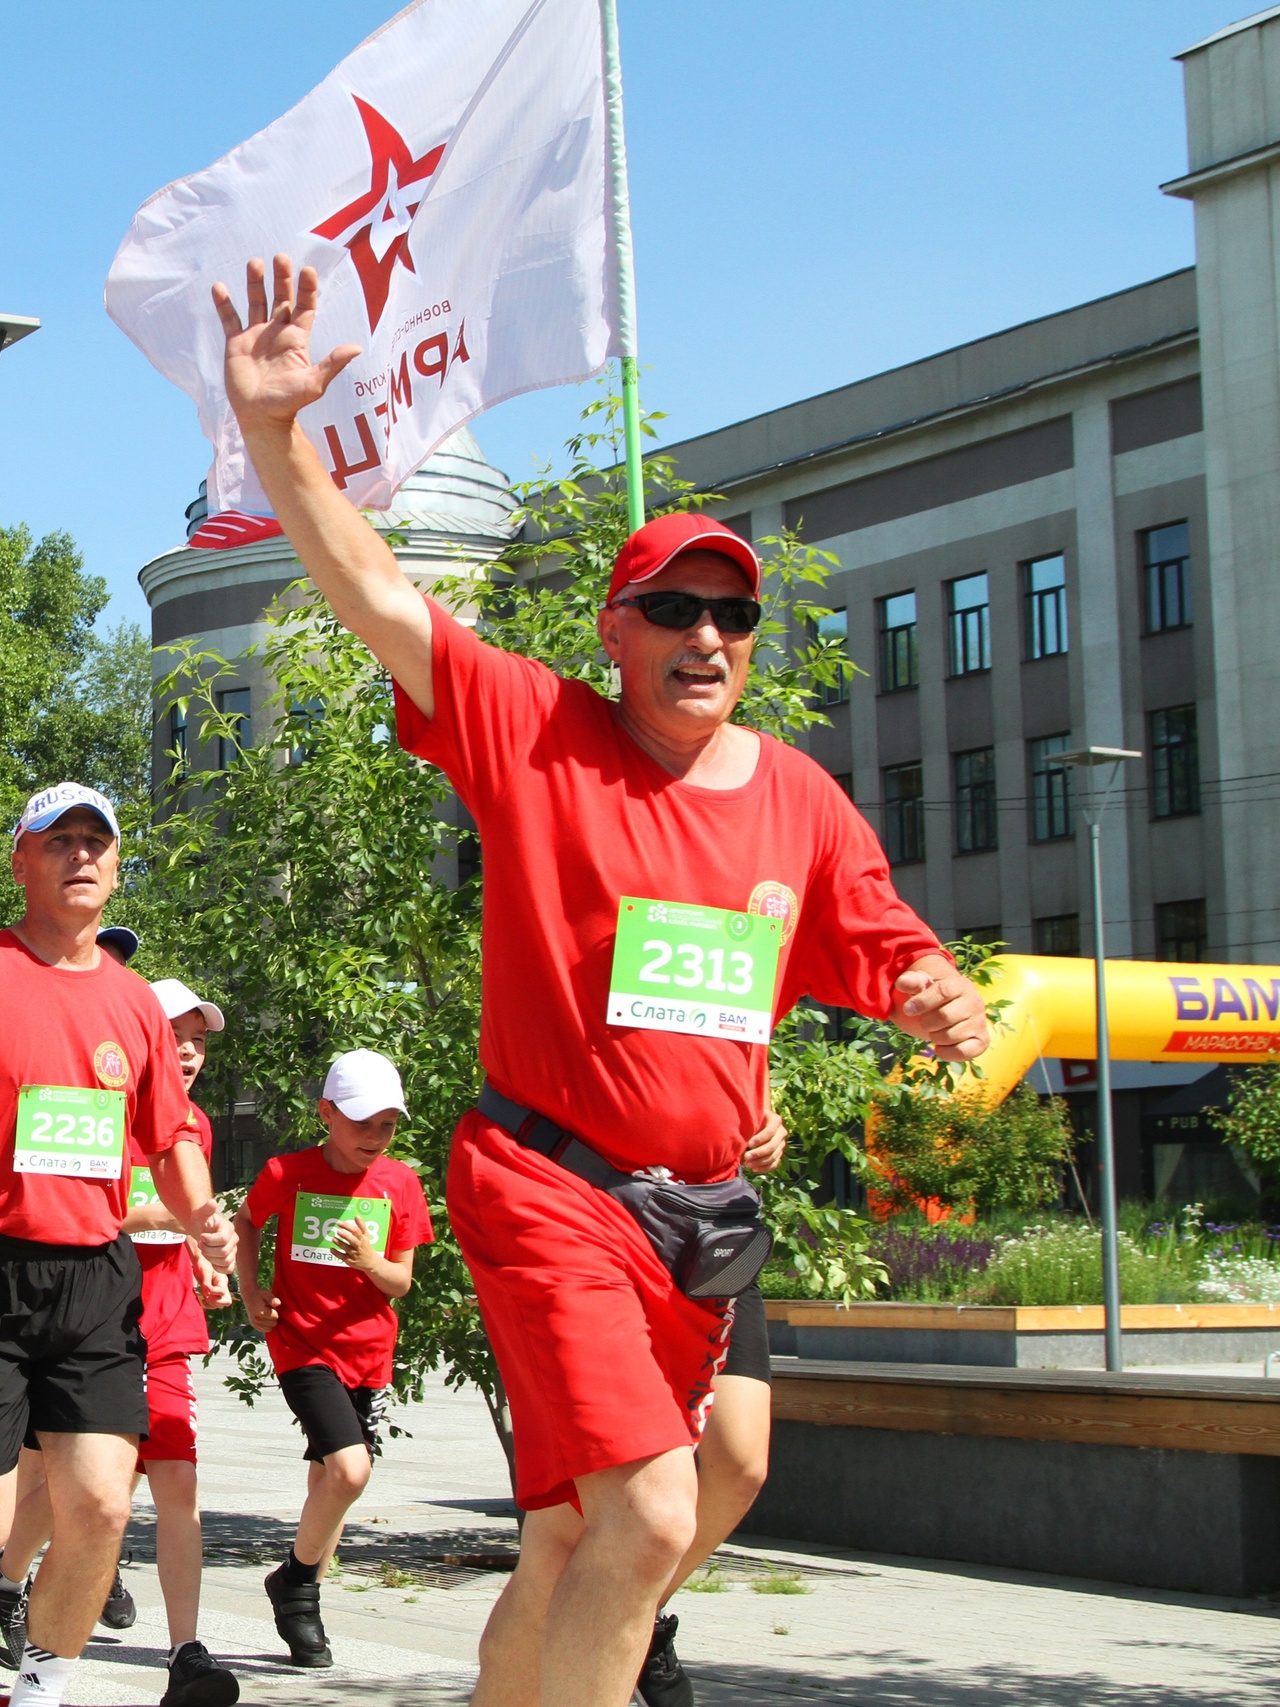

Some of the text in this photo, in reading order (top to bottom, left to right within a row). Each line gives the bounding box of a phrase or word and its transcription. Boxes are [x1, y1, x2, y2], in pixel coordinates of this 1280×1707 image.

[34, 788, 110, 814] RUSSIA
[639, 939, 754, 995] 2313
[630, 1001, 747, 1025] Слата БАМ
[1183, 1035, 1272, 1050] МАРАФОНЫ
[30, 1112, 115, 1147] 2236
[1170, 1117, 1199, 1128] PUB
[29, 1155, 109, 1168] Слата БАМ
[302, 1249, 333, 1261] Слата
[713, 1248, 734, 1257] SPORT
